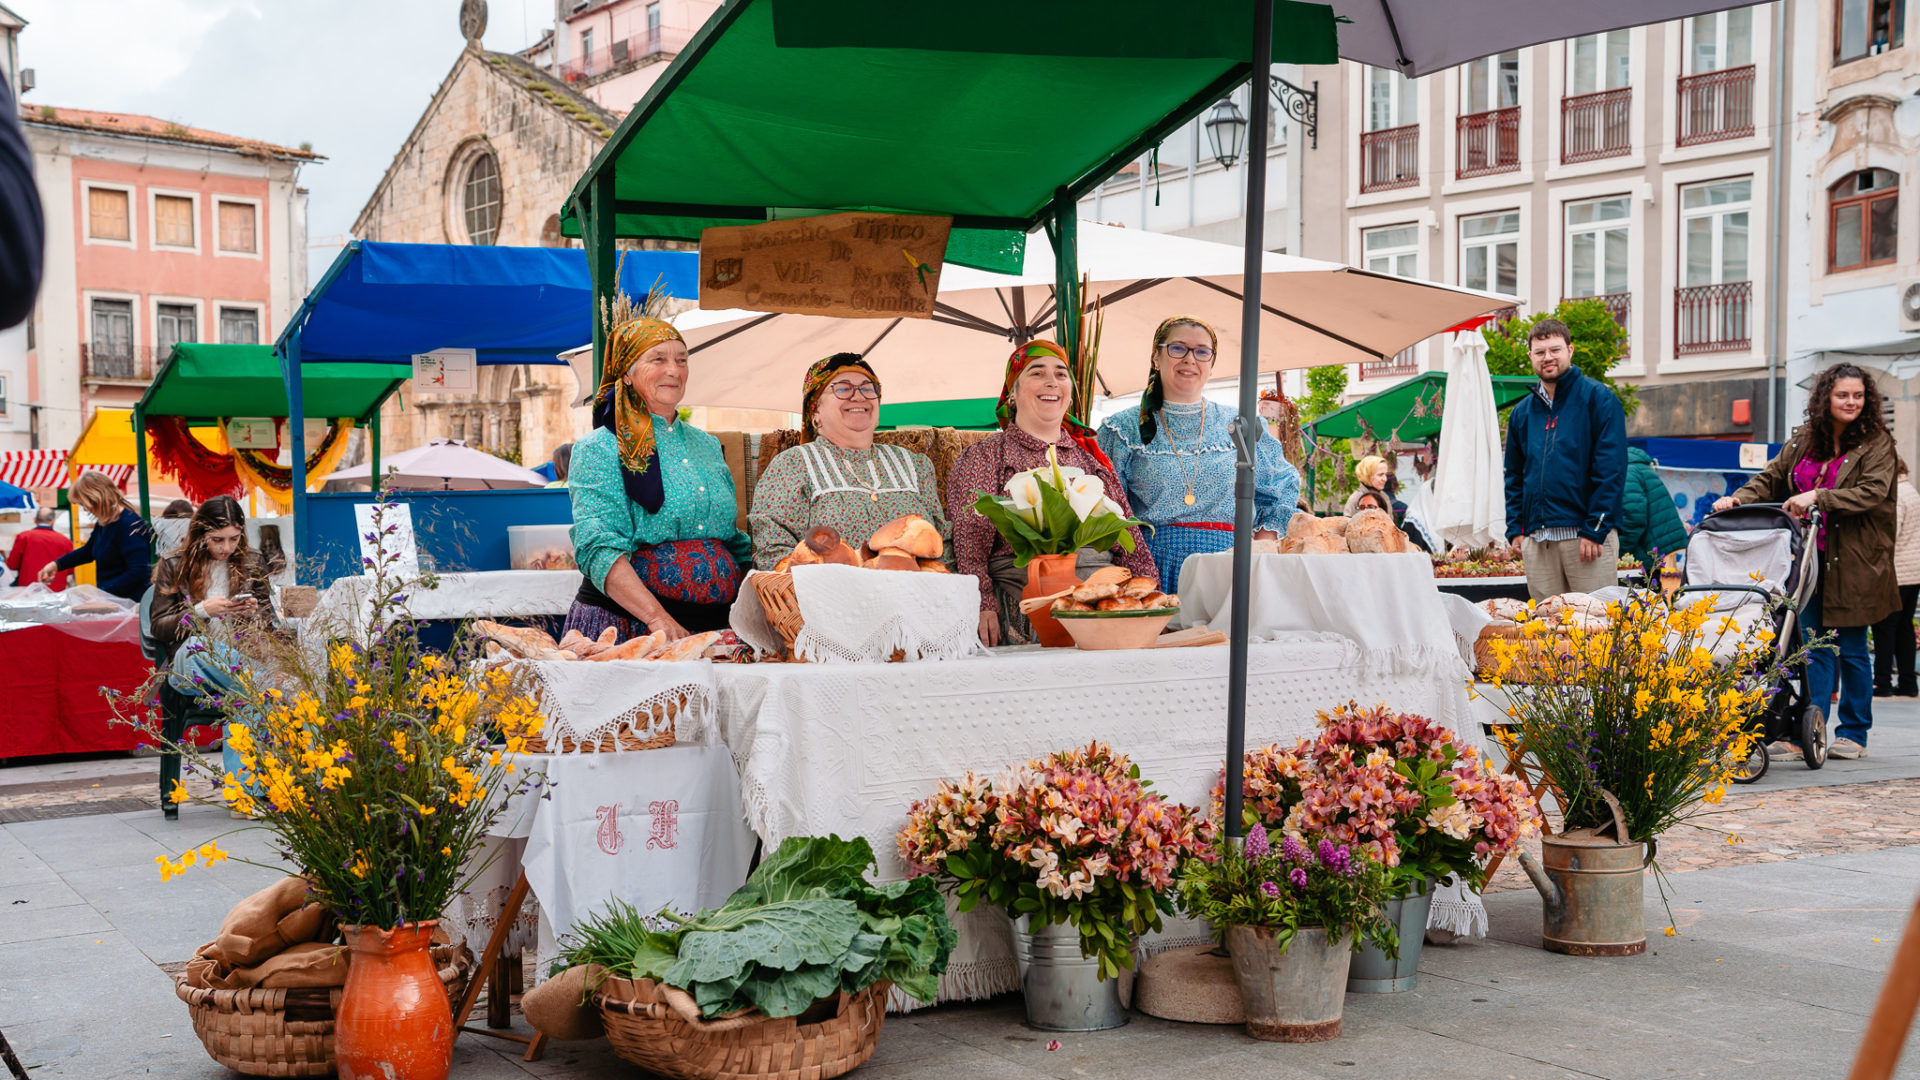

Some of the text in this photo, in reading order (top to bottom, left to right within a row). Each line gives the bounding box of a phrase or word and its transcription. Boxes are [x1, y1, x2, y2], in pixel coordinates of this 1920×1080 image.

[830, 240, 853, 263] De
[773, 261, 912, 290] Vila Nova
